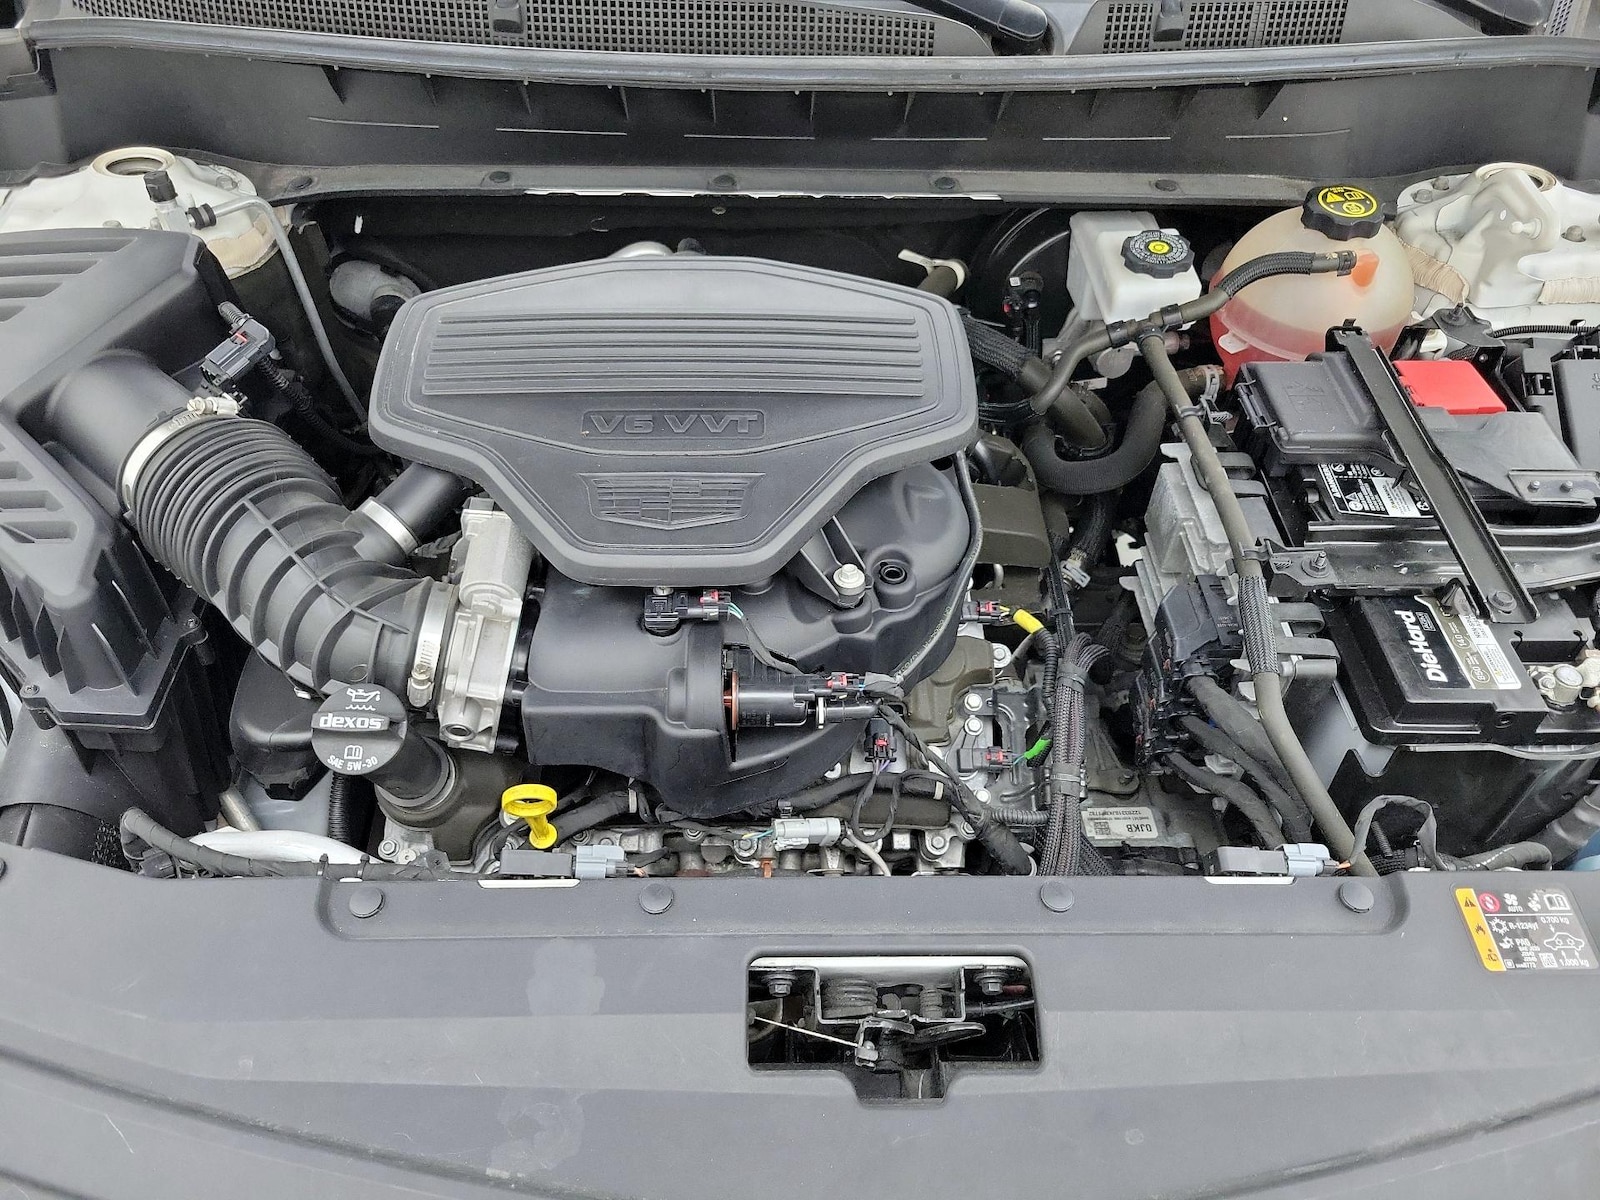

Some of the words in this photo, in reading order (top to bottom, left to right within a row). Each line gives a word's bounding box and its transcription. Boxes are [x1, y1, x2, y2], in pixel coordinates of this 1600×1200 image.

[590, 414, 655, 434] V6
[663, 414, 758, 434] VVT
[1394, 610, 1449, 683] DieHard
[1454, 634, 1467, 647] 140
[1472, 666, 1486, 682] 850
[319, 713, 385, 729] dexos
[327, 754, 345, 769] SAE
[346, 755, 378, 771] 5W-30
[1508, 922, 1539, 931] R-1234yf
[1559, 917, 1570, 925] kg
[1580, 959, 1590, 968] kg
